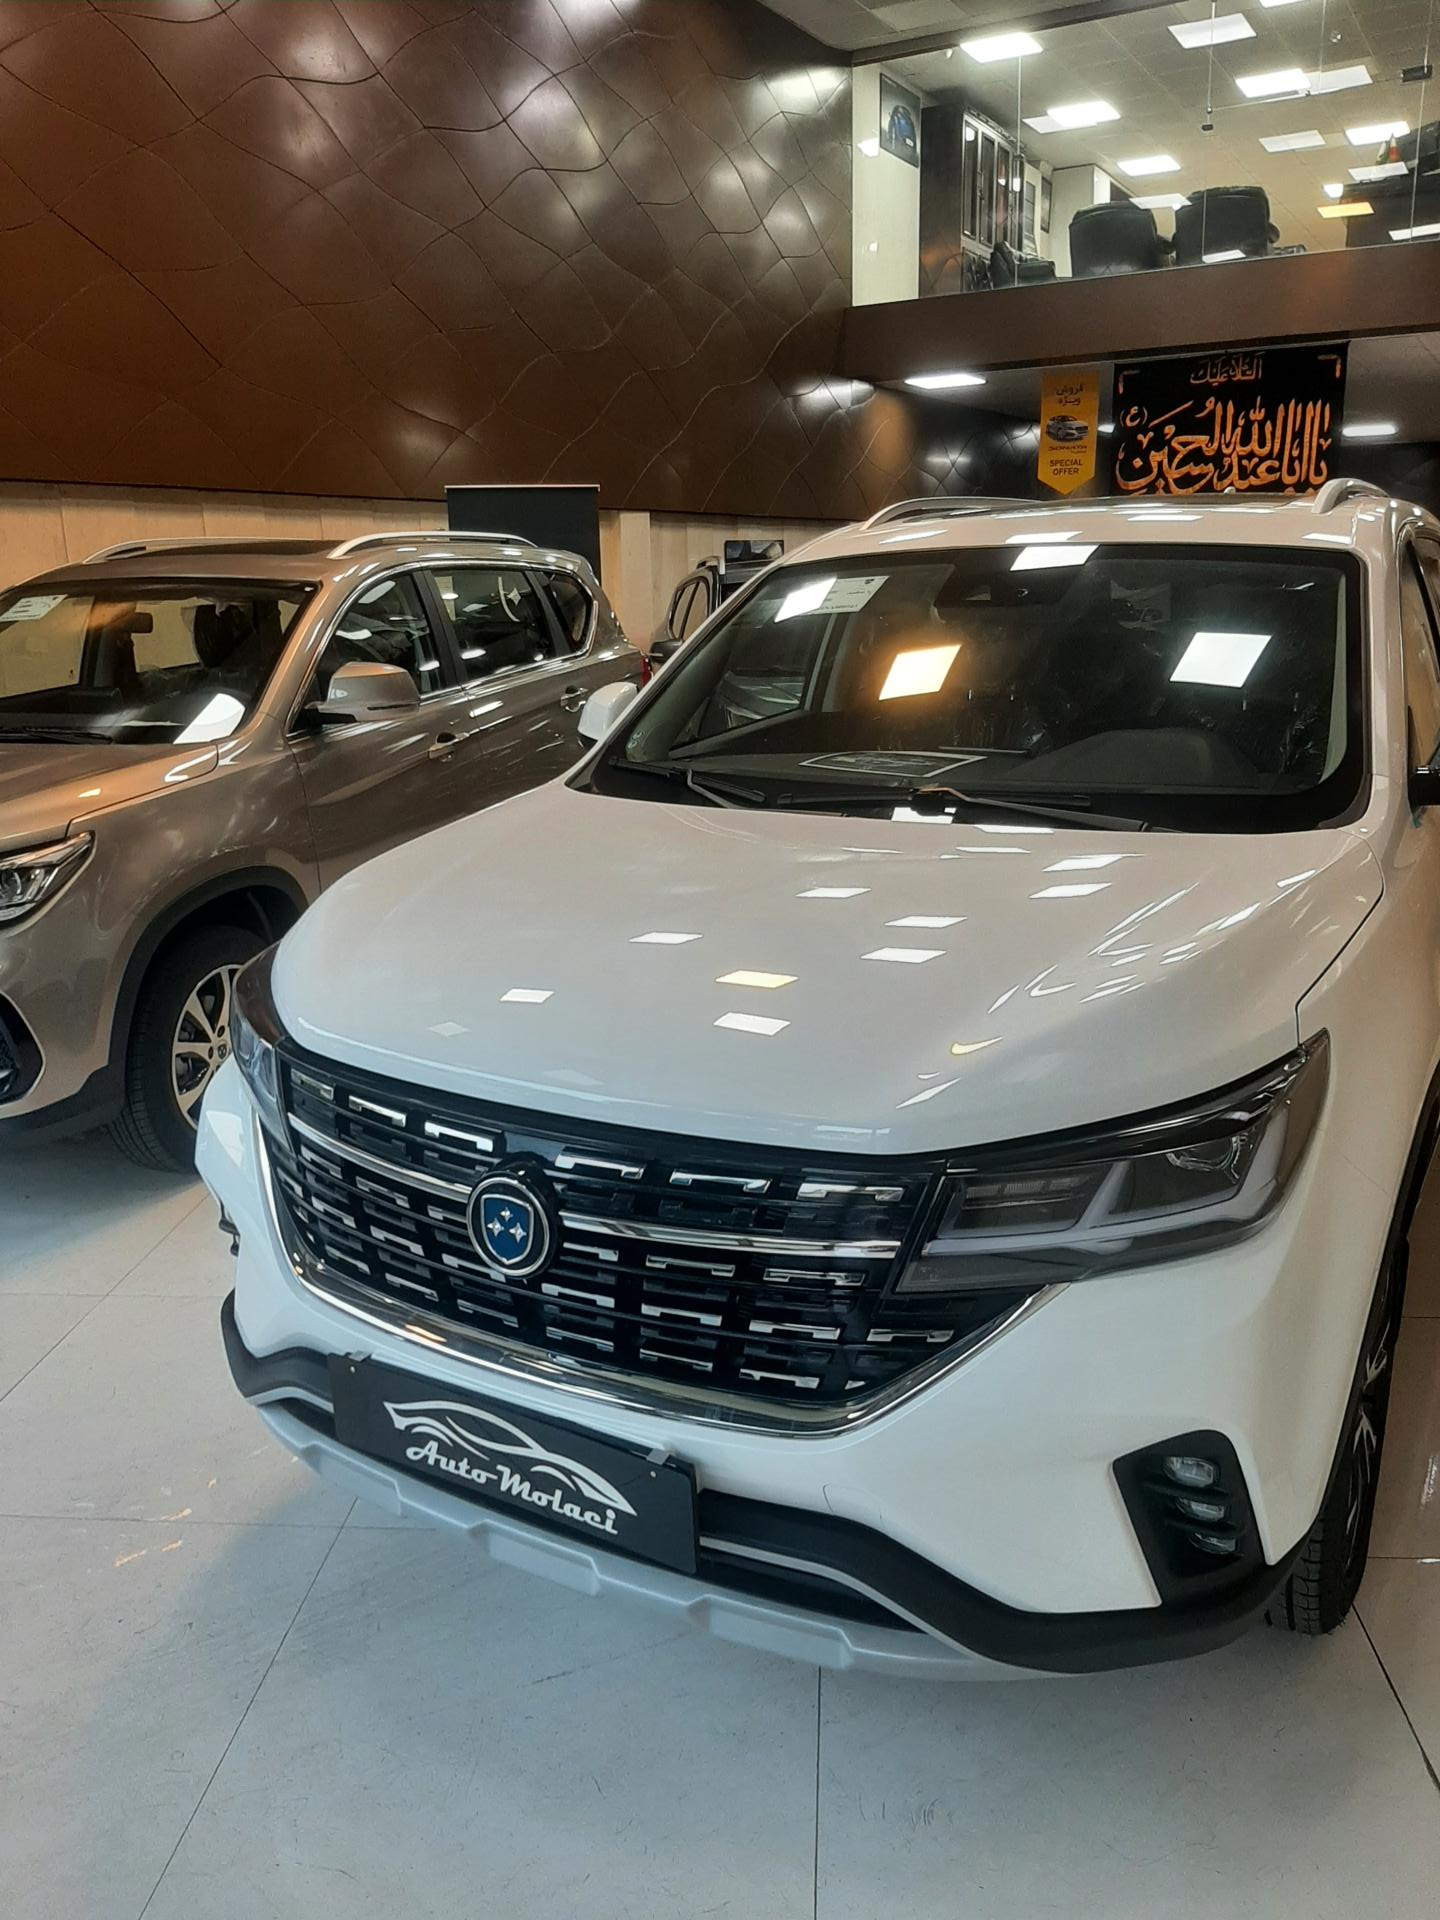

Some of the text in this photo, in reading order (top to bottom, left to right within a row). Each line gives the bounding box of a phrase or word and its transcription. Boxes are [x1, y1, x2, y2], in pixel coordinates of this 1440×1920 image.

[1056, 385, 1083, 396] فروش
[1049, 458, 1083, 468] SPECIAL
[1052, 467, 1079, 476] OFFER
[405, 1440, 618, 1535] Auto Molaci
